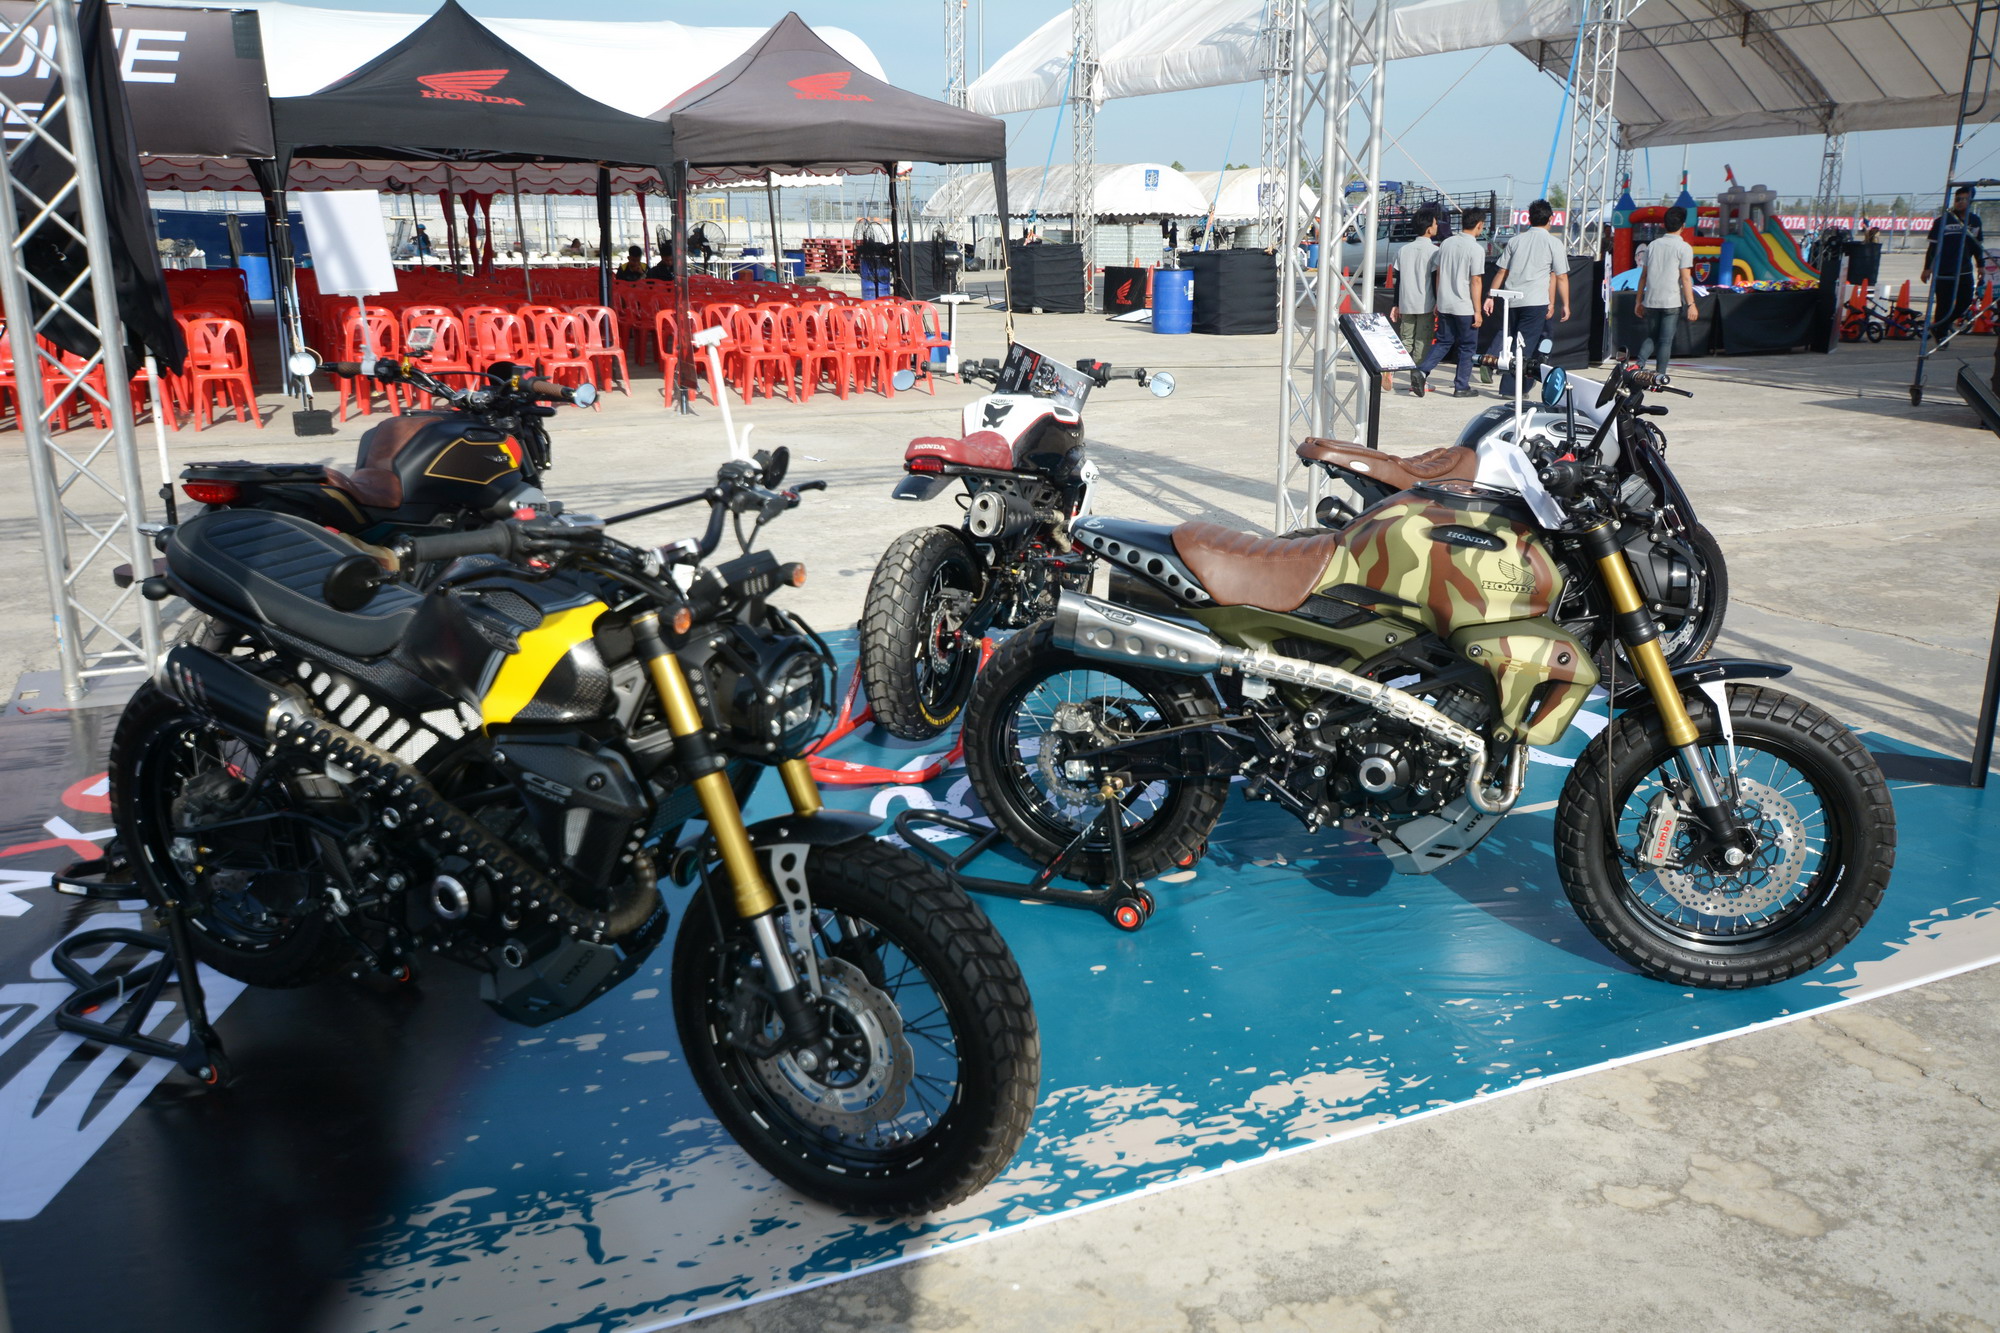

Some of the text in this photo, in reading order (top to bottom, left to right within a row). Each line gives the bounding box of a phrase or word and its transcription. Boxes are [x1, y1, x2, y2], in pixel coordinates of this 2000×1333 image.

[420, 89, 526, 106] HONDA
[914, 443, 947, 451] HONDA
[1446, 531, 1493, 547] HONDA
[1481, 580, 1539, 595] HONDA
[1653, 819, 1672, 859] brembo
